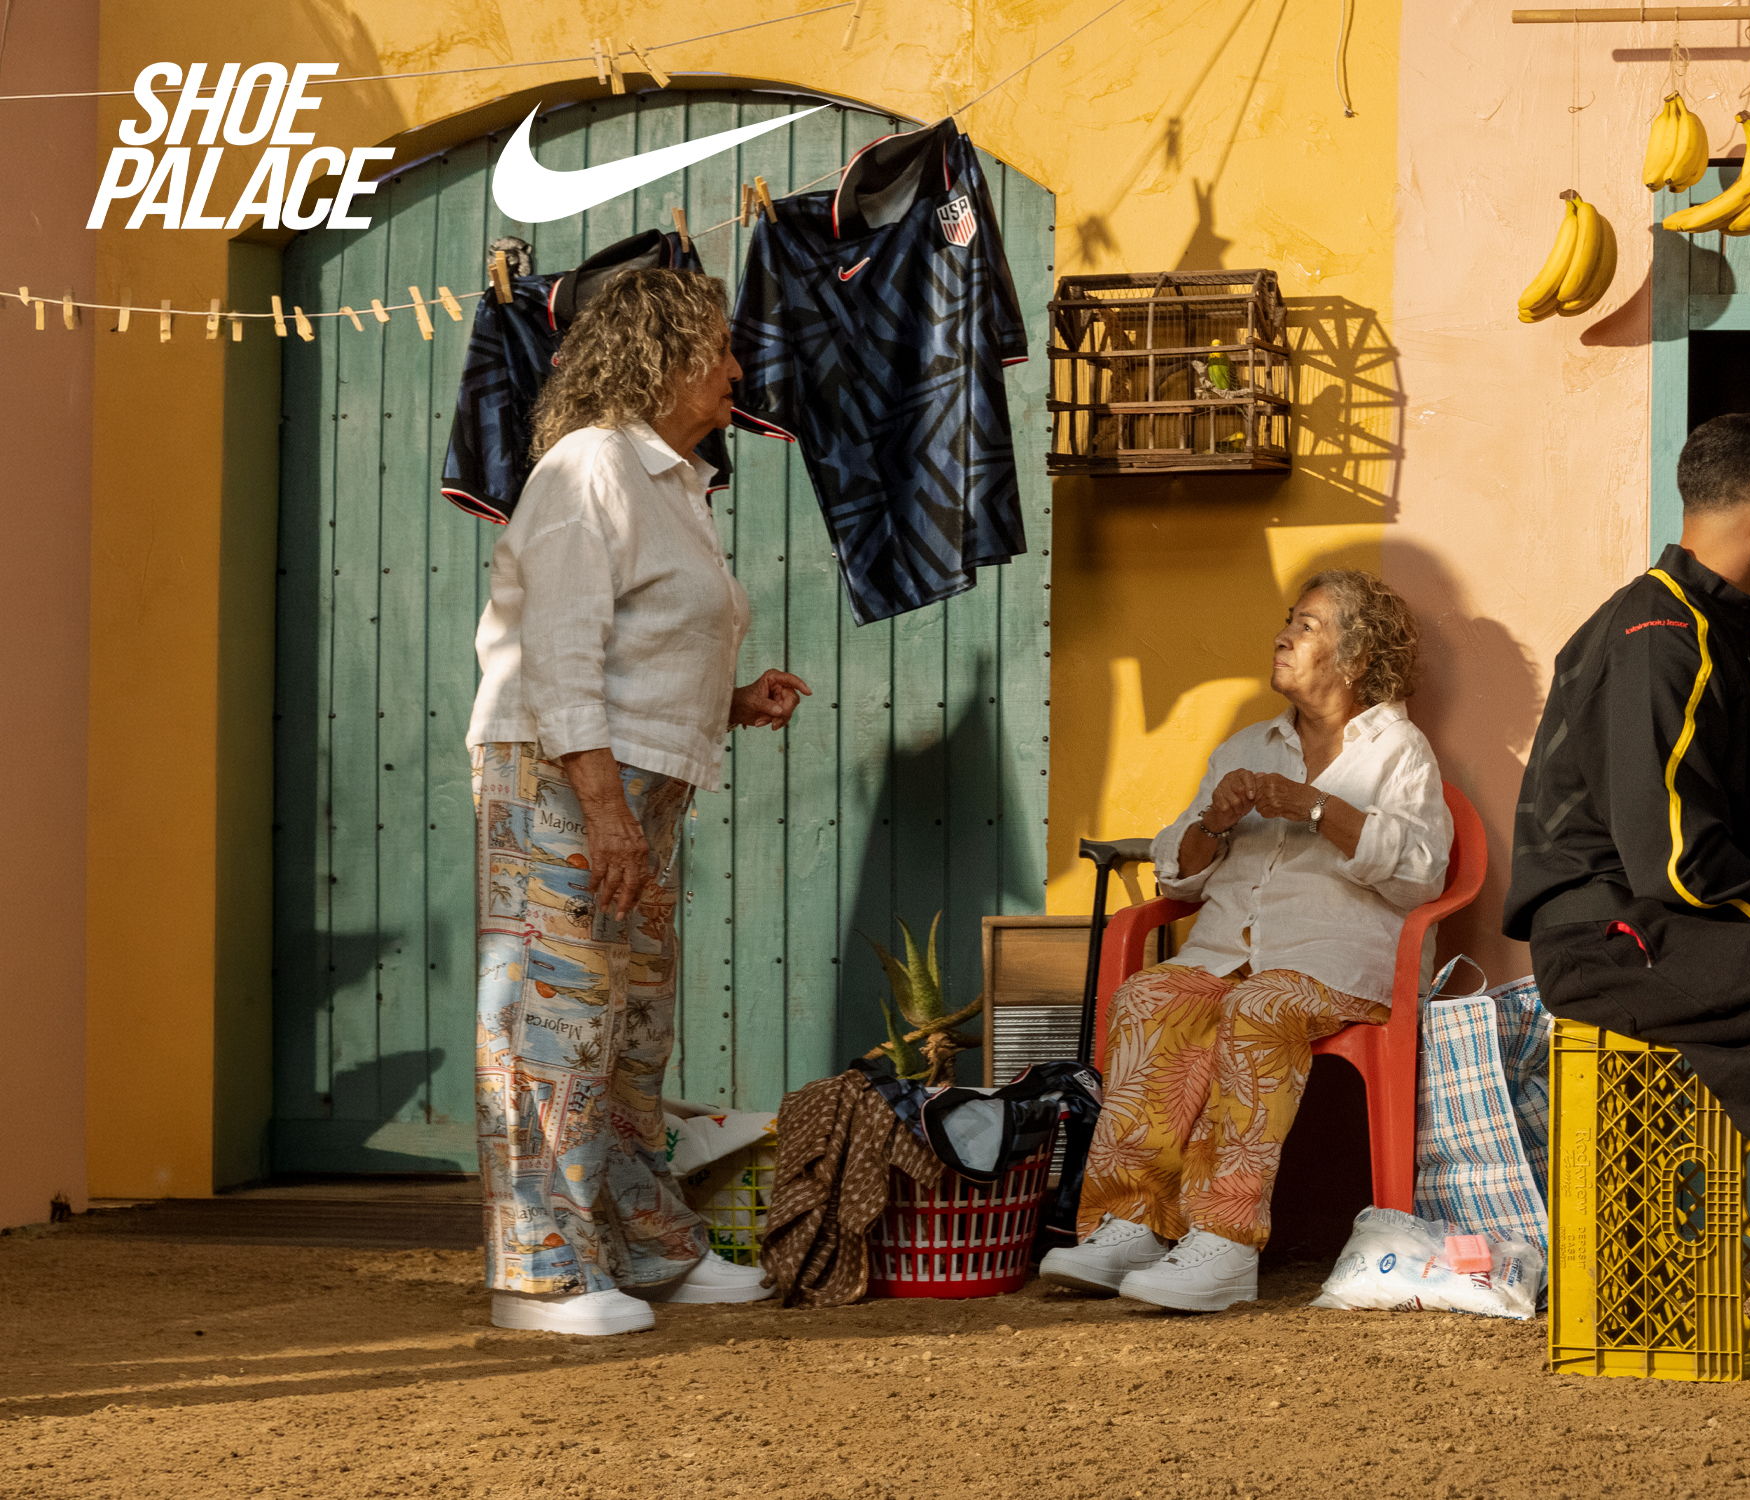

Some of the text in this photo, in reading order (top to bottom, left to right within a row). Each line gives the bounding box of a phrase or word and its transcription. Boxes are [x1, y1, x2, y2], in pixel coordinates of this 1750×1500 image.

[939, 198, 968, 221] USA
[539, 809, 589, 835] Majorc
[525, 1013, 584, 1041] Majorca
[1566, 1234, 1576, 1262] CASE
[1577, 1226, 1587, 1270] DEPOSIT
